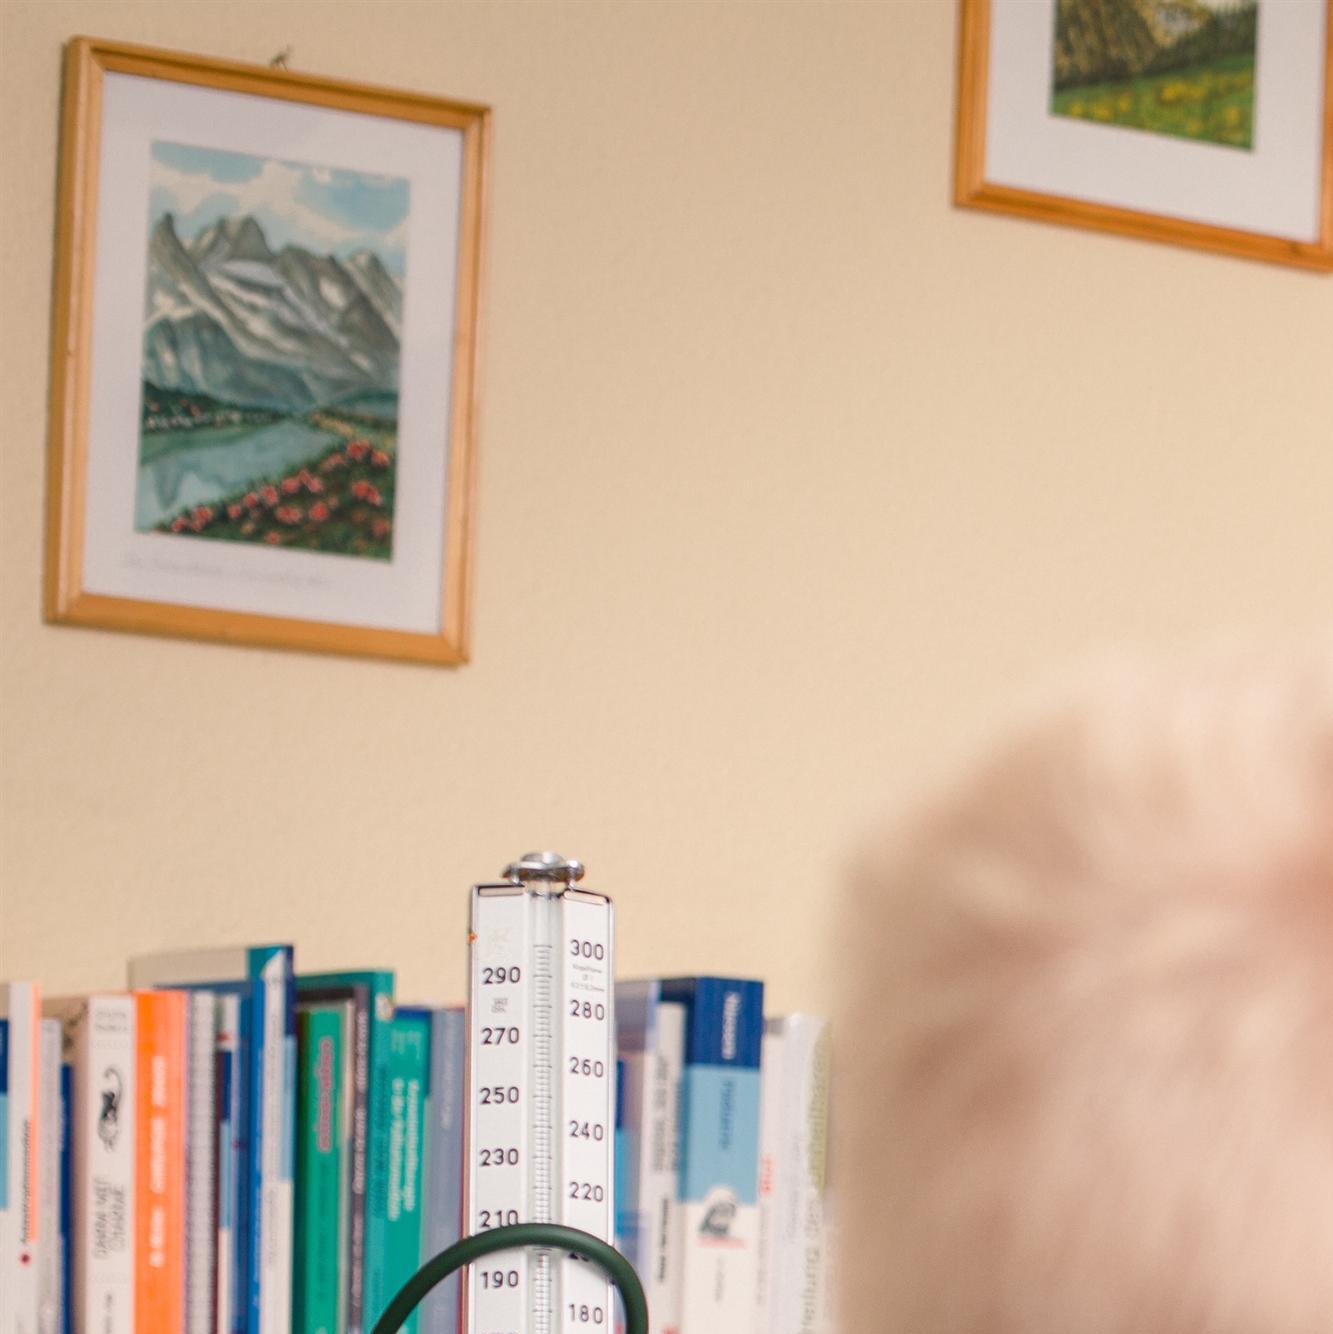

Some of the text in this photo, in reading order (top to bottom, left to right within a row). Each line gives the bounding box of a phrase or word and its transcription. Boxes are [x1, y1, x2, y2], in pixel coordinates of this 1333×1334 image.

[569, 938, 605, 961] 300
[482, 965, 521, 986] 290
[569, 998, 605, 1022] 280
[480, 1026, 520, 1046] 270
[569, 1055, 604, 1079] 260
[479, 1085, 520, 1106] 250
[569, 1119, 604, 1142] 240
[479, 1147, 520, 1168] 230
[569, 1180, 604, 1203] 220
[479, 1209, 520, 1229] 210
[480, 1269, 519, 1291] 190
[568, 1303, 604, 1326] 180
